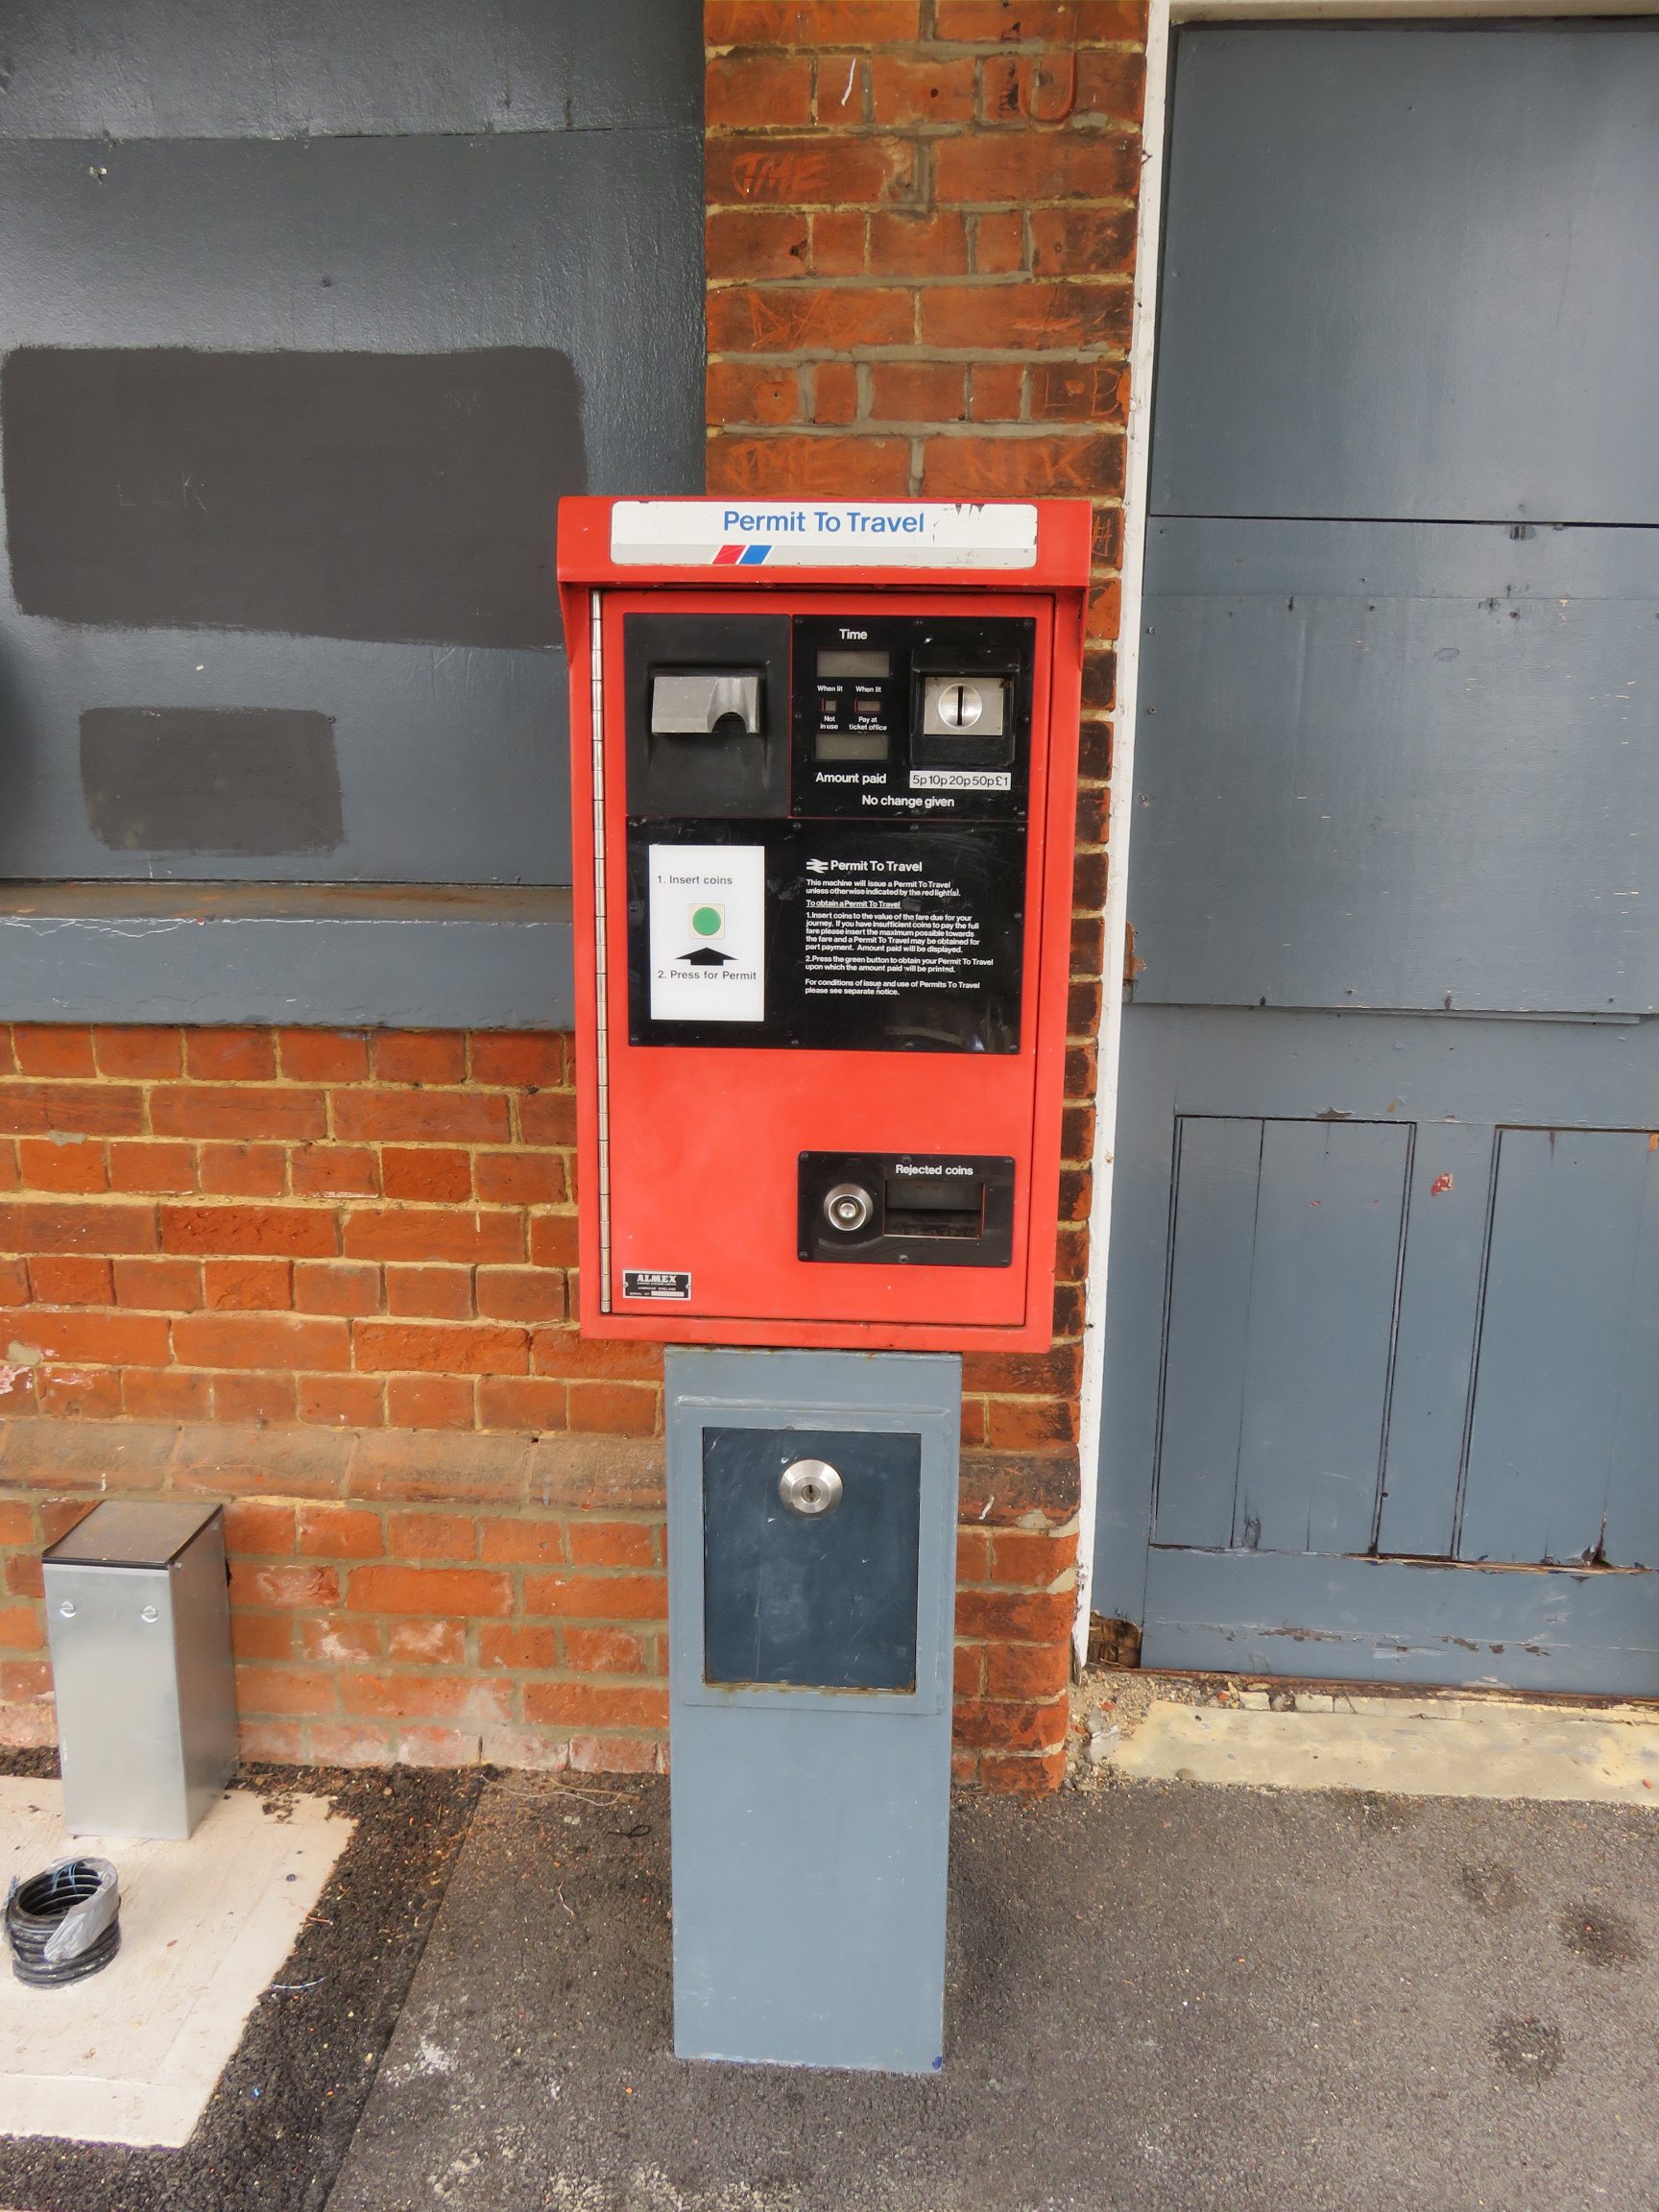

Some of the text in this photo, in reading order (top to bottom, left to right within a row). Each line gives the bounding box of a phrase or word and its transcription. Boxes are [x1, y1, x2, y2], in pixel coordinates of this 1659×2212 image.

[724, 511, 925, 533] Permit To Travel
[838, 628, 868, 639] Time
[815, 772, 887, 785] Amount paid
[912, 775, 1009, 787] 5p 10p 20p 50p £1
[862, 794, 954, 808] No change given
[830, 859, 922, 873] Permit To Travel
[657, 876, 733, 885] 1. Insert coins
[823, 878, 853, 887] machine
[928, 880, 950, 889] Travel
[830, 887, 865, 896] otherwise
[935, 889, 960, 898] light(s).
[816, 899, 839, 907] obtain
[806, 920, 833, 928] journey.
[820, 927, 845, 936] please
[915, 929, 945, 938] possible
[805, 943, 820, 951] part
[822, 944, 854, 952] payment.
[927, 946, 963, 954] displayed.
[887, 964, 902, 973] paid
[928, 965, 955, 974] printed.
[658, 970, 757, 980] 2. Press for Permit
[818, 978, 854, 987] conditions
[805, 987, 829, 996] please
[844, 987, 875, 997] separate
[895, 1164, 974, 1176] Rejected coins
[637, 1274, 677, 1283] ALMEX
